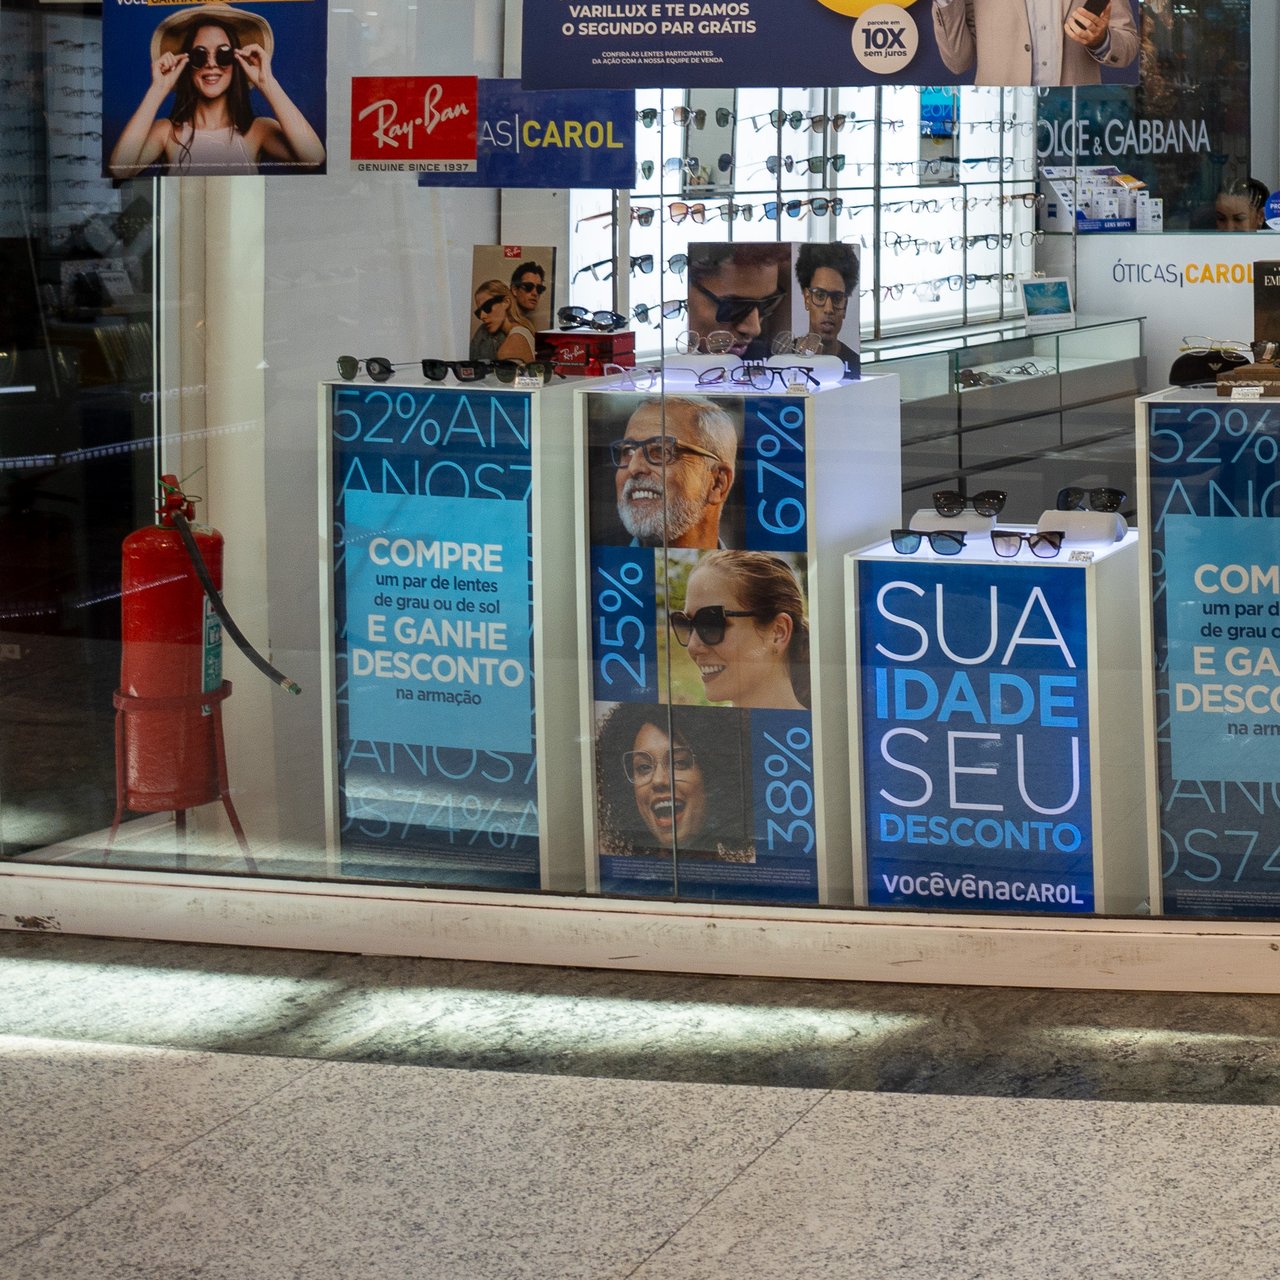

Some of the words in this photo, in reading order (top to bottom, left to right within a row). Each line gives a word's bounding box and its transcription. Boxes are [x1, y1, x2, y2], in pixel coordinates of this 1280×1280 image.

[569, 4, 647, 18] VARILLUX
[651, 4, 662, 16] E
[665, 3, 685, 16] TE
[689, 2, 750, 16] DAMOS
[562, 23, 575, 36] O
[578, 22, 658, 36] SEGUNDO
[661, 21, 694, 34] PAR
[698, 18, 757, 34] GRÁTIS
[867, 19, 889, 27] parcele
[861, 28, 906, 49] 10X
[863, 50, 882, 58] sem
[884, 48, 908, 59] juros
[522, 120, 624, 149] CAROL
[1093, 136, 1103, 155] &
[1104, 119, 1211, 157] GABBANA
[358, 163, 405, 172] GENUINE
[408, 163, 441, 172] SINCE
[444, 163, 469, 172] 1937
[369, 538, 503, 572] COMPRE
[376, 574, 398, 586] um
[403, 577, 427, 589] par
[431, 575, 449, 589] de
[454, 576, 498, 592] lentes
[374, 592, 392, 607] de
[396, 596, 429, 610] grau
[434, 599, 452, 610] ou
[456, 598, 475, 612] de
[479, 600, 500, 613] sol
[368, 614, 387, 642] E
[394, 616, 508, 650] GANHE
[352, 648, 524, 687] DESCONTO
[396, 688, 413, 700] na
[418, 690, 482, 706] armação
